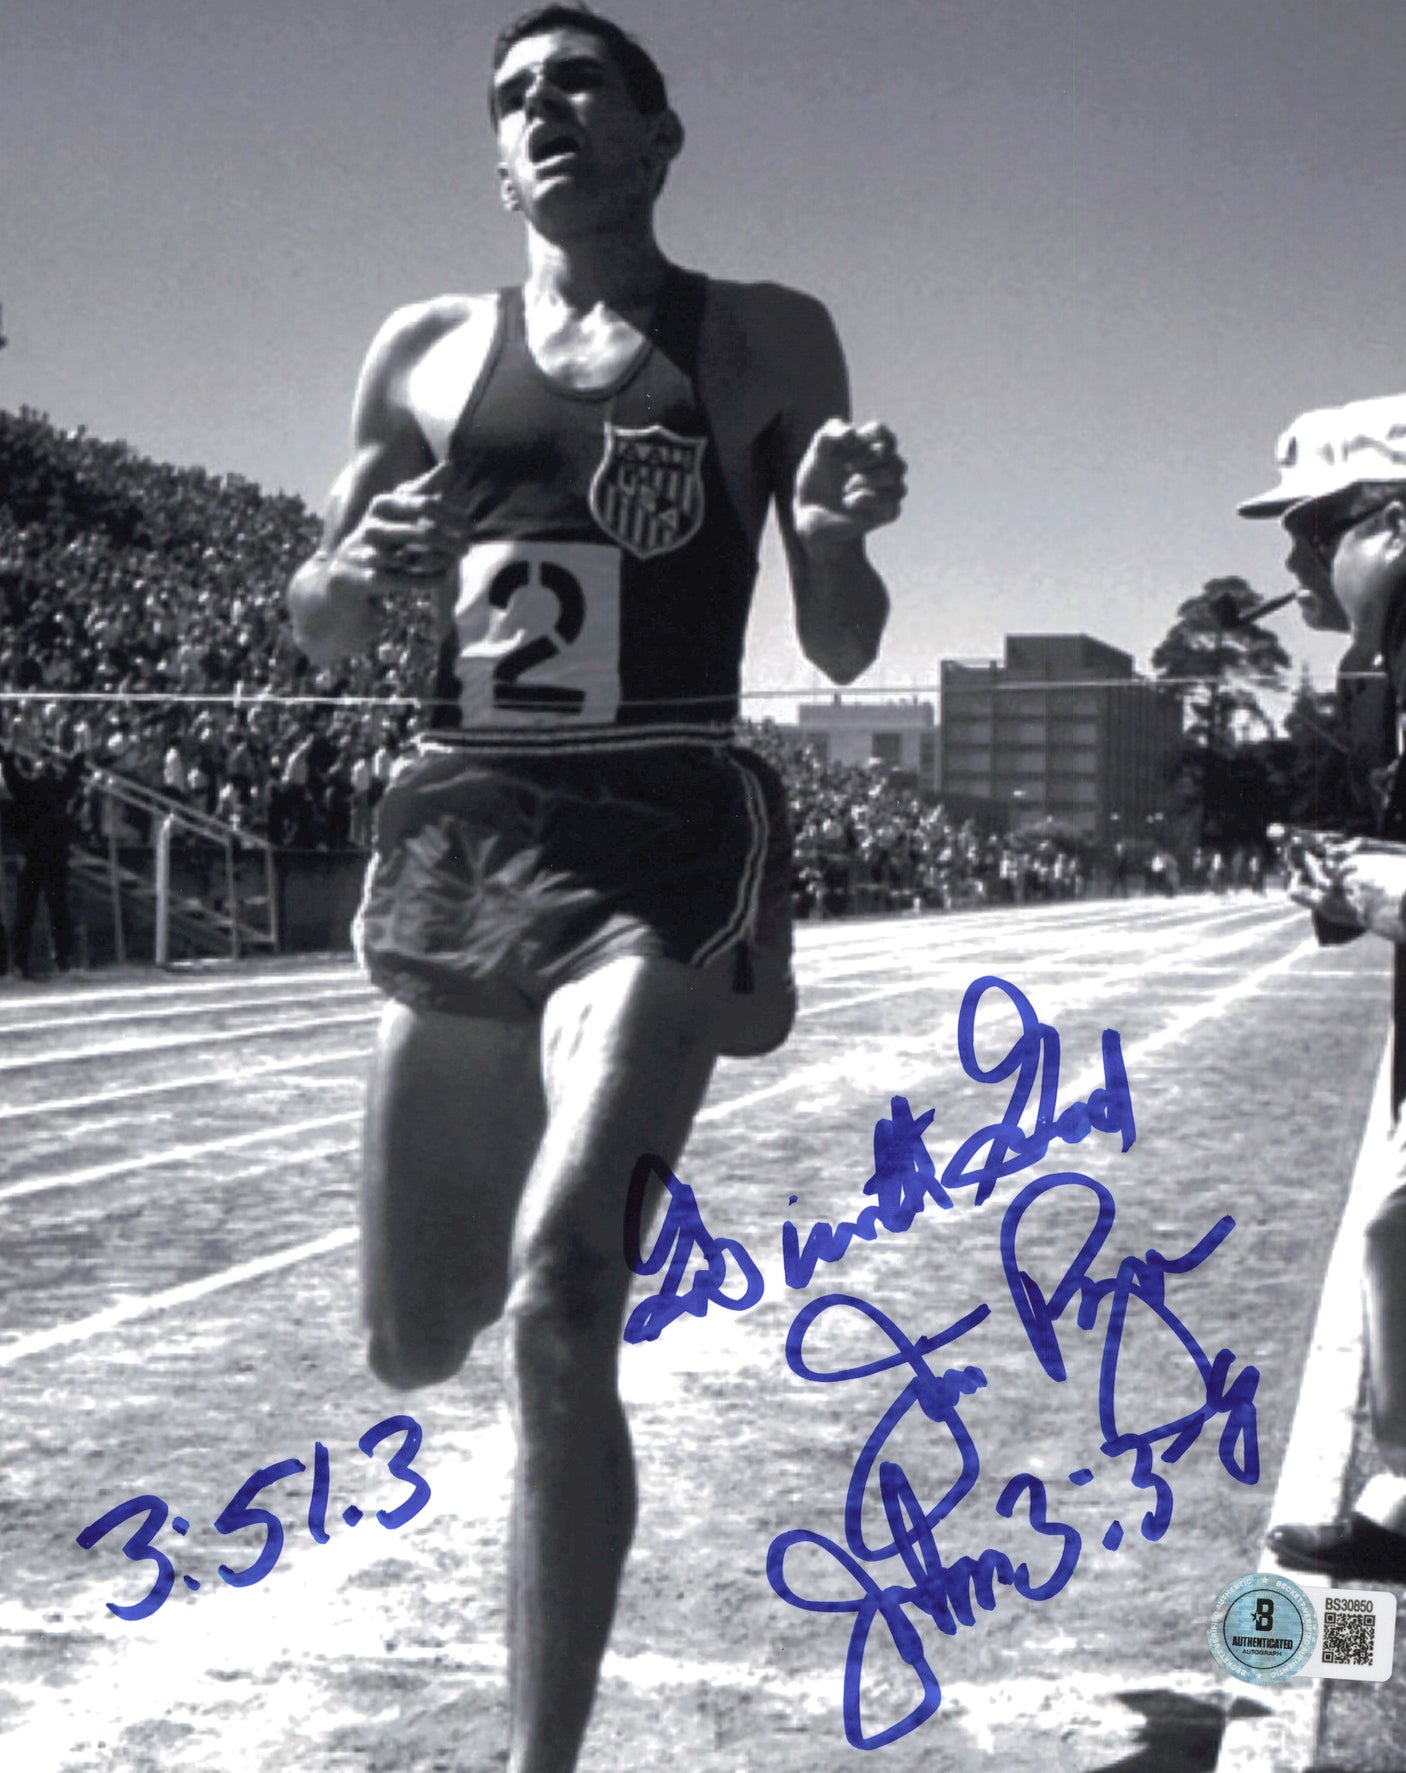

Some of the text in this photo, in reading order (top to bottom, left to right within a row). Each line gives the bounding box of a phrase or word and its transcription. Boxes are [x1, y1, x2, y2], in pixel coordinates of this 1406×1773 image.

[489, 561, 586, 715] 2
[76, 1415, 431, 1621] 3:51.3
[1256, 1598, 1274, 1631] B
[1325, 1598, 1374, 1613] BS30850
[1232, 1635, 1294, 1650] AUTHENTICATED
[1242, 1649, 1283, 1657] AUTOGRAPH
